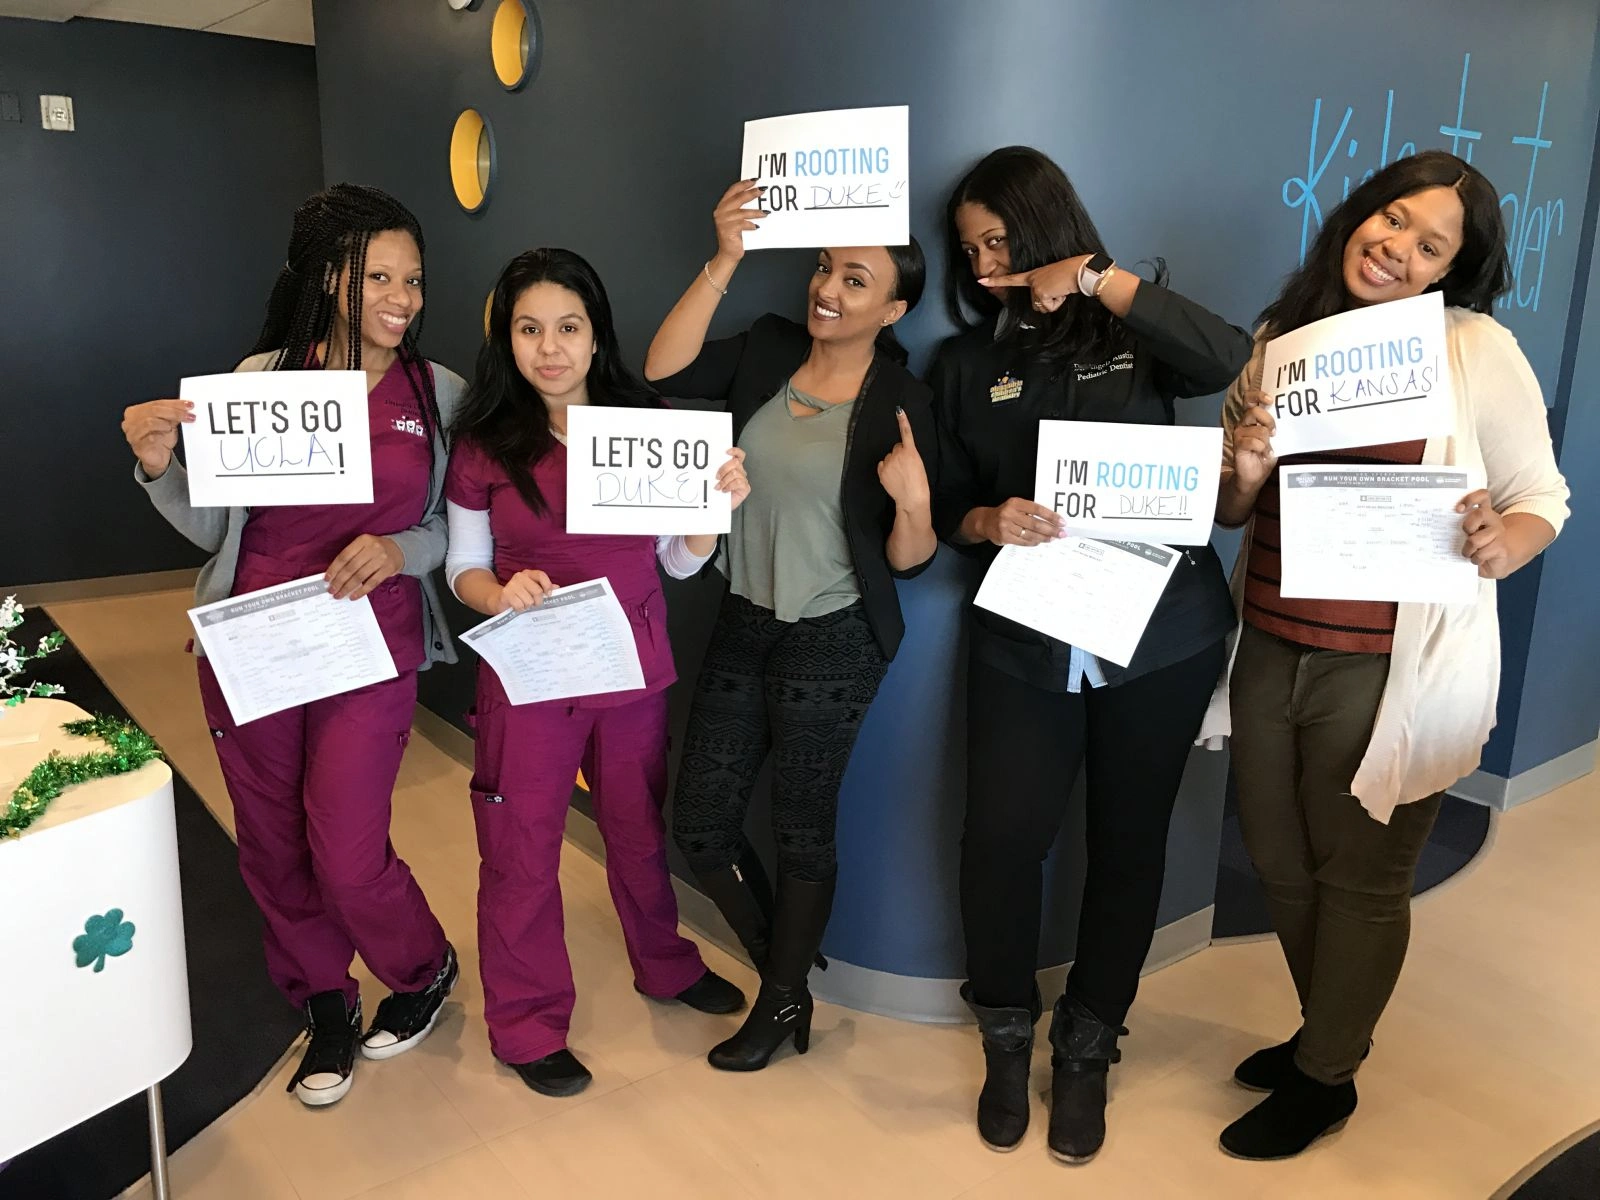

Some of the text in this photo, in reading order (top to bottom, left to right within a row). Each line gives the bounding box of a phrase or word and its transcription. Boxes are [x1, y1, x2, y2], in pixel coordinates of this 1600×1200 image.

[758, 147, 889, 179] I'M ROOTING
[758, 185, 799, 212] FOR
[1077, 361, 1134, 381] Pediatric Dentist
[1276, 336, 1424, 389] I'M ROOTING
[208, 400, 342, 434] LET'S GO
[1274, 388, 1322, 420] FOR
[592, 436, 709, 469] LET'S GO
[1055, 459, 1199, 492] I'M ROOTING
[1053, 491, 1097, 519] FOR
